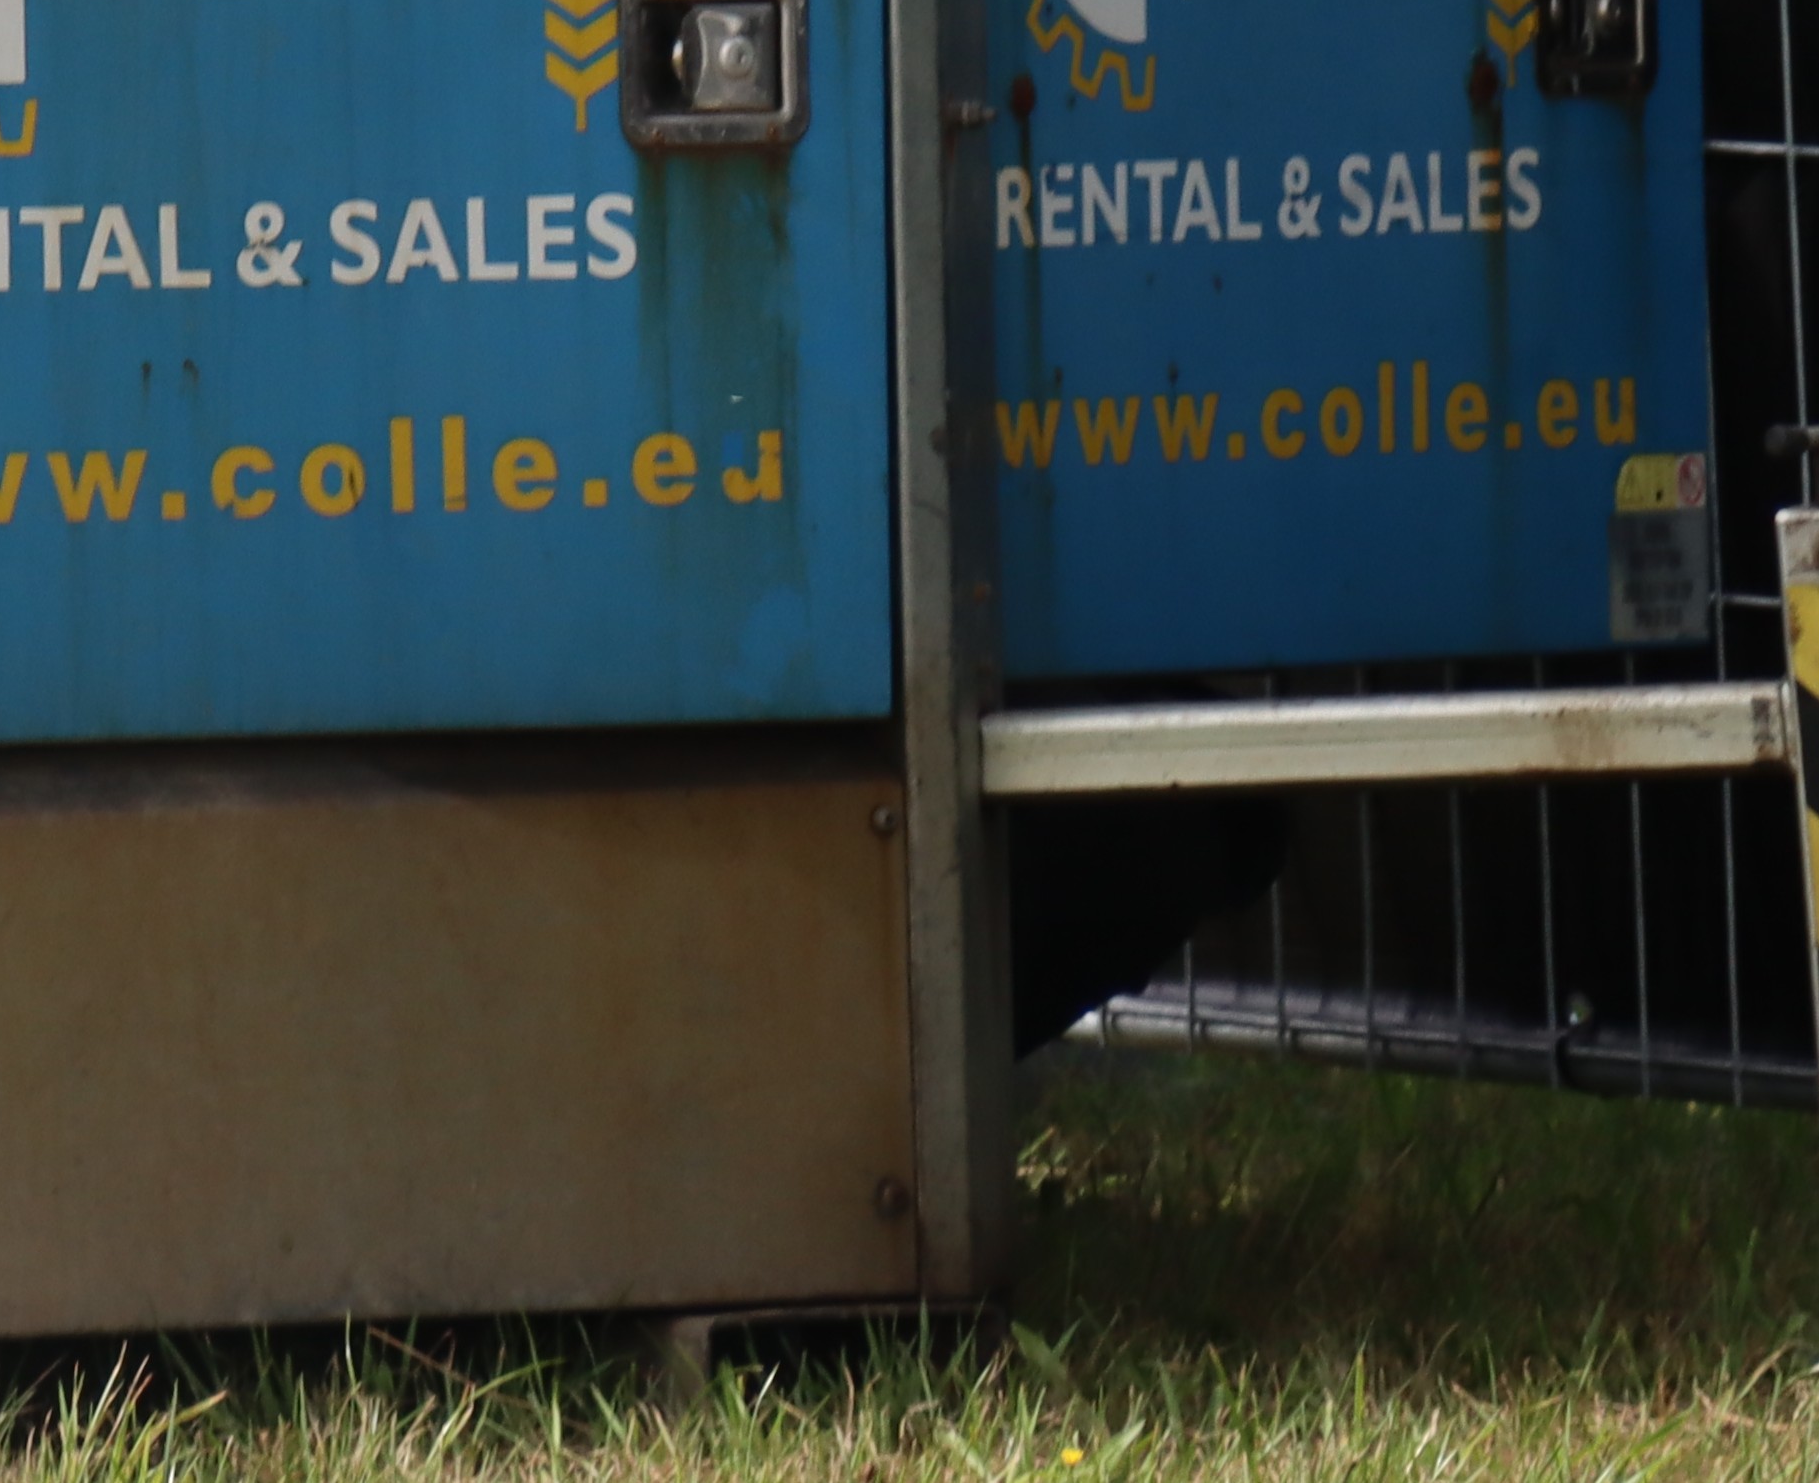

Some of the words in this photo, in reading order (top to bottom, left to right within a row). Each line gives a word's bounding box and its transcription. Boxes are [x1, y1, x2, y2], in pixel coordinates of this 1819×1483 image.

[235, 201, 304, 288] &
[328, 193, 638, 285] SALES
[995, 156, 1263, 250] RENTAL
[1277, 156, 1322, 240] &
[1339, 147, 1543, 235] SALES
[995, 360, 1637, 469] www.colle.eu
